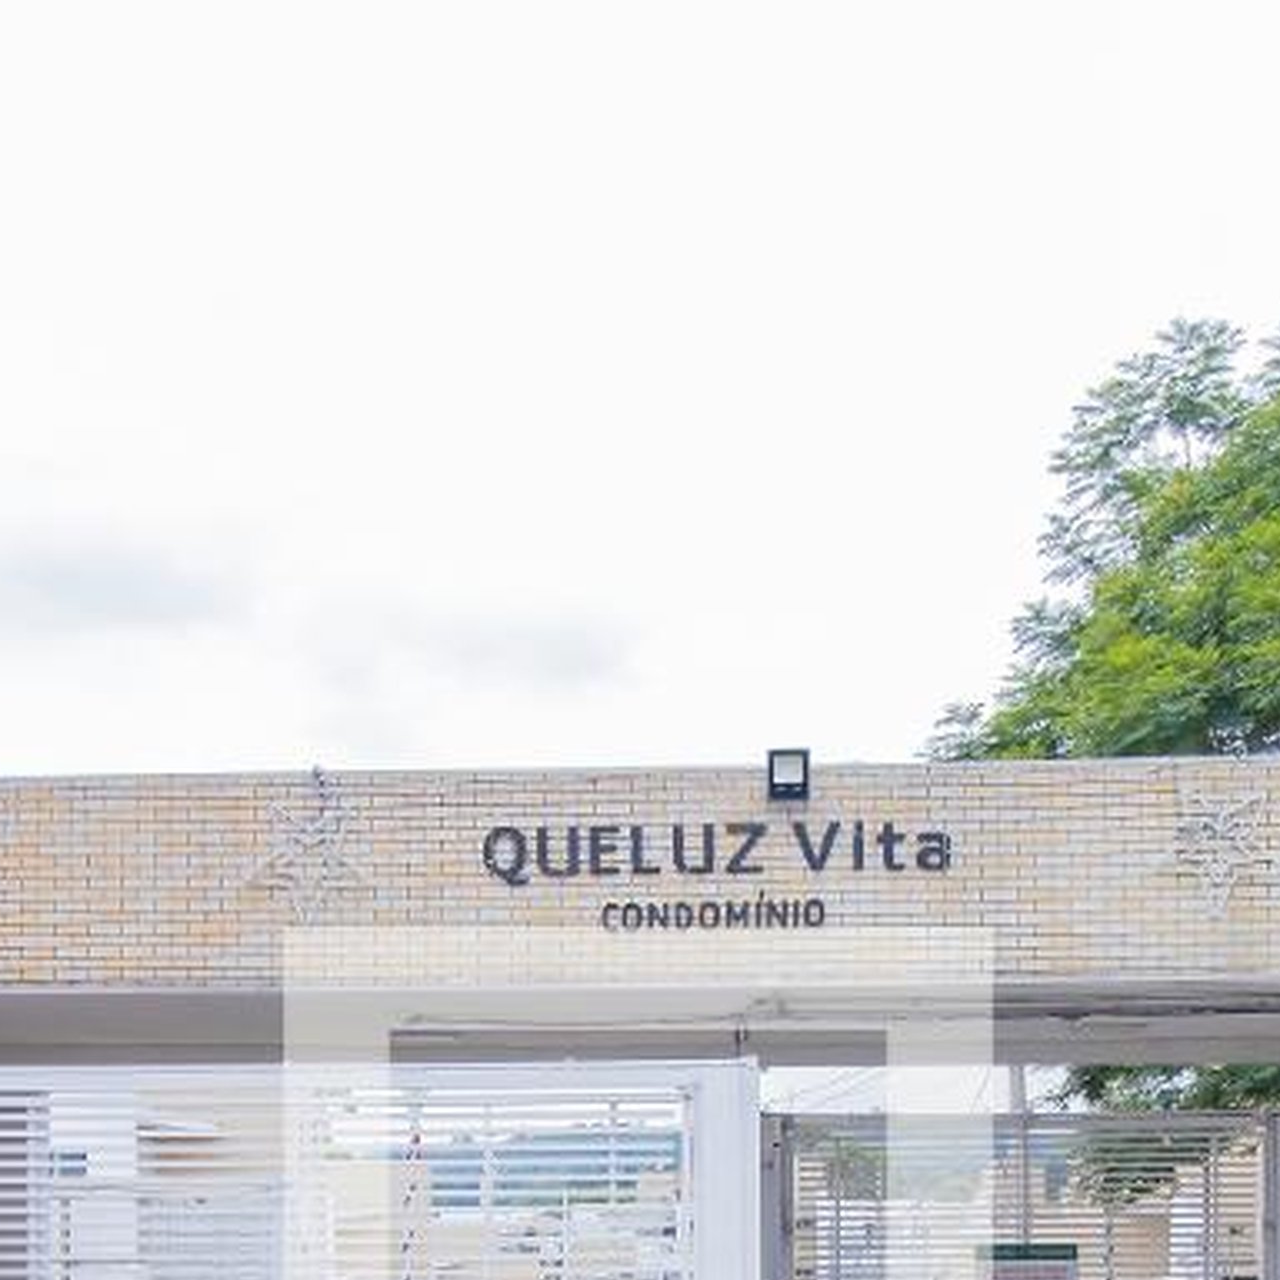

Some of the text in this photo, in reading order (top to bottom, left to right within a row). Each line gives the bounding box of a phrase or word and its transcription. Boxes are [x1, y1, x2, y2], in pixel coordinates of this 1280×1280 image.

[482, 818, 953, 886] QUELUZ Vita
[601, 890, 825, 930] CONDOMÍNIO
